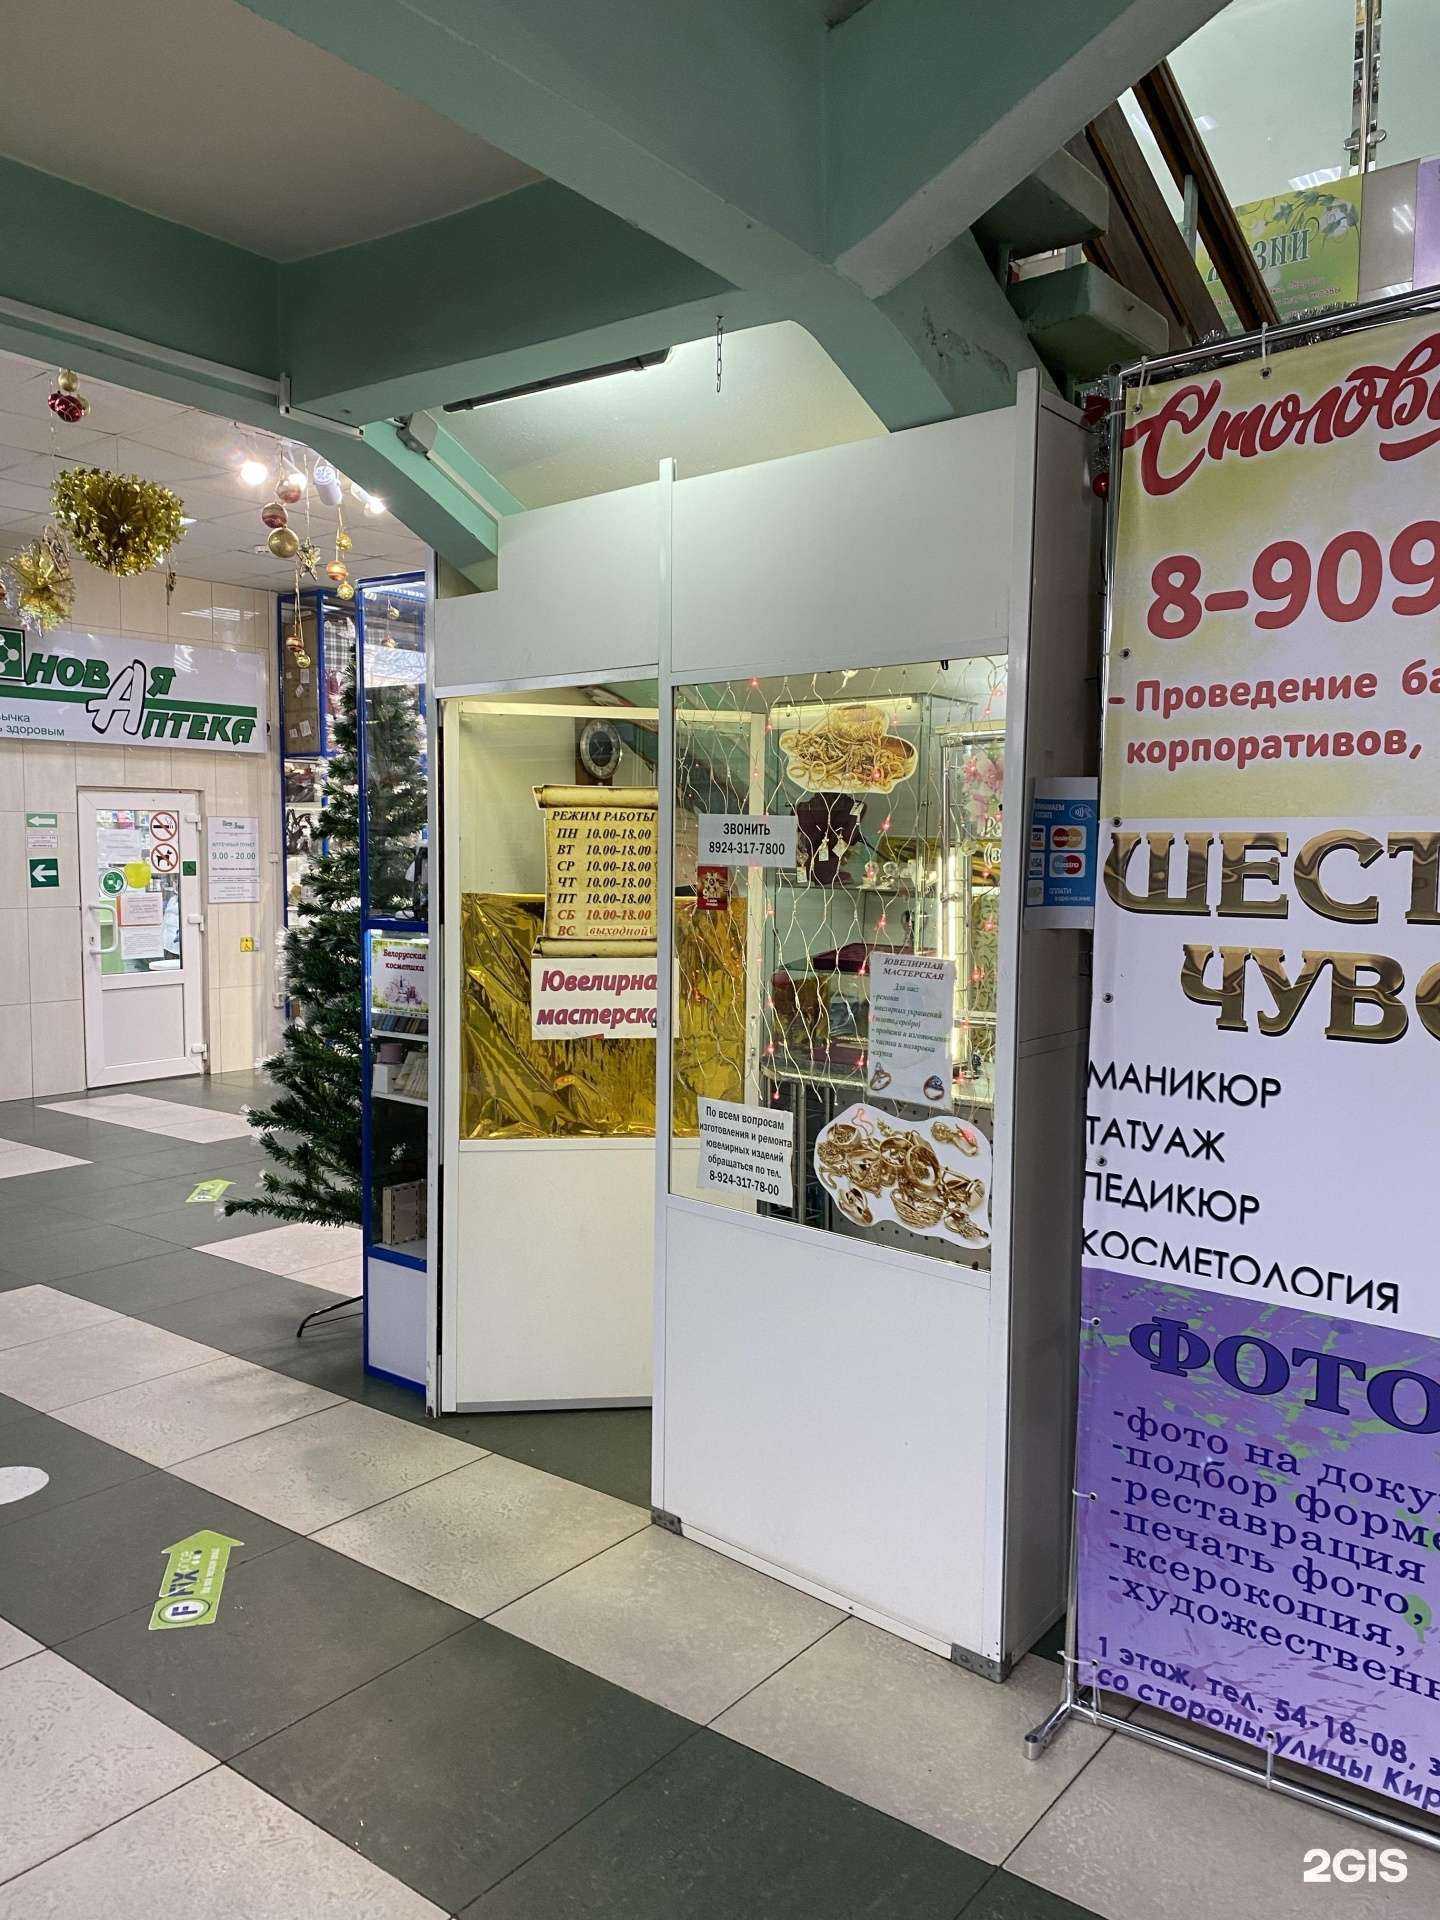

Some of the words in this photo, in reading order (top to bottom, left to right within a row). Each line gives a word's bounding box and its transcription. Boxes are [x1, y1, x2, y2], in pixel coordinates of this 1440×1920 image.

[1137, 671, 1377, 718] Проведение
[6, 725, 64, 736] здоровым
[1127, 728, 1422, 770] корпоративов,
[552, 811, 600, 821] РЕЖИМ
[604, 811, 656, 822] РАБОТЫ
[723, 823, 770, 835] ЗВОНИТЬ
[557, 828, 578, 838] ПН
[586, 828, 651, 839] 10.00-18.00
[557, 844, 574, 854] ВТ
[586, 844, 651, 855] 10.00-18.00
[709, 842, 785, 855] 8924-317-7800
[557, 861, 574, 871] СР
[586, 861, 651, 872] 10.00-18.00
[1103, 830, 1440, 924] ШЕСТ
[557, 877, 577, 887] ЧТ
[586, 877, 651, 888] 10.00-18.00
[557, 893, 577, 903] ПТ
[586, 893, 651, 904] 10.00-18.00
[557, 910, 575, 920] СБ
[586, 910, 651, 921] 10.00-18.00
[557, 926, 576, 936] ВС
[589, 926, 649, 937] выходной
[883, 968, 944, 981] МАСТЕРСКАЯ
[884, 957, 944, 970] ЮВЕЛИРНАЯ
[541, 970, 657, 996] Ювелирна
[1181, 945, 1440, 1044] ЧУВ
[1087, 1060, 1281, 1108] МАНИКЮР
[706, 1106, 716, 1117] По
[719, 1111, 739, 1121] всем
[742, 1115, 784, 1130] вопросам
[700, 1123, 749, 1140] изготовления
[751, 1132, 756, 1140] и
[758, 1134, 792, 1148] ремонта
[1086, 1116, 1225, 1162] ТАТУАЖ
[706, 1140, 749, 1155] ювелирных
[752, 1150, 784, 1162] изделий
[708, 1154, 753, 1171] обращаться
[755, 1166, 765, 1174] по
[767, 1168, 781, 1178] тел.
[710, 1170, 779, 1195] 8-924-317-78-00
[1085, 1170, 1260, 1224] ПЕДИКЮР
[1082, 1228, 1399, 1313] КОСМЕТОЛОГИЯ
[1129, 1317, 1440, 1434] ФОТО
[1113, 1407, 1229, 1454] -фото
[1245, 1443, 1301, 1476] на
[1318, 1463, 1440, 1514] доку
[1112, 1443, 1277, 1508] -подбор
[1111, 1476, 1426, 1585] -реставрация
[1110, 1509, 1274, 1574] -печать
[1292, 1556, 1423, 1625] фото,
[1109, 1542, 1405, 1656] -ксерокопия,
[1098, 1636, 1108, 1657] 1
[1119, 1648, 1197, 1690] этаж,
[1206, 1677, 1263, 1714] тел.
[1275, 1699, 1416, 1770] 54-18-08,
[1098, 1669, 1129, 1691] со
[1138, 1683, 1264, 1742] стороны
[1272, 1731, 1372, 1782] улицы
